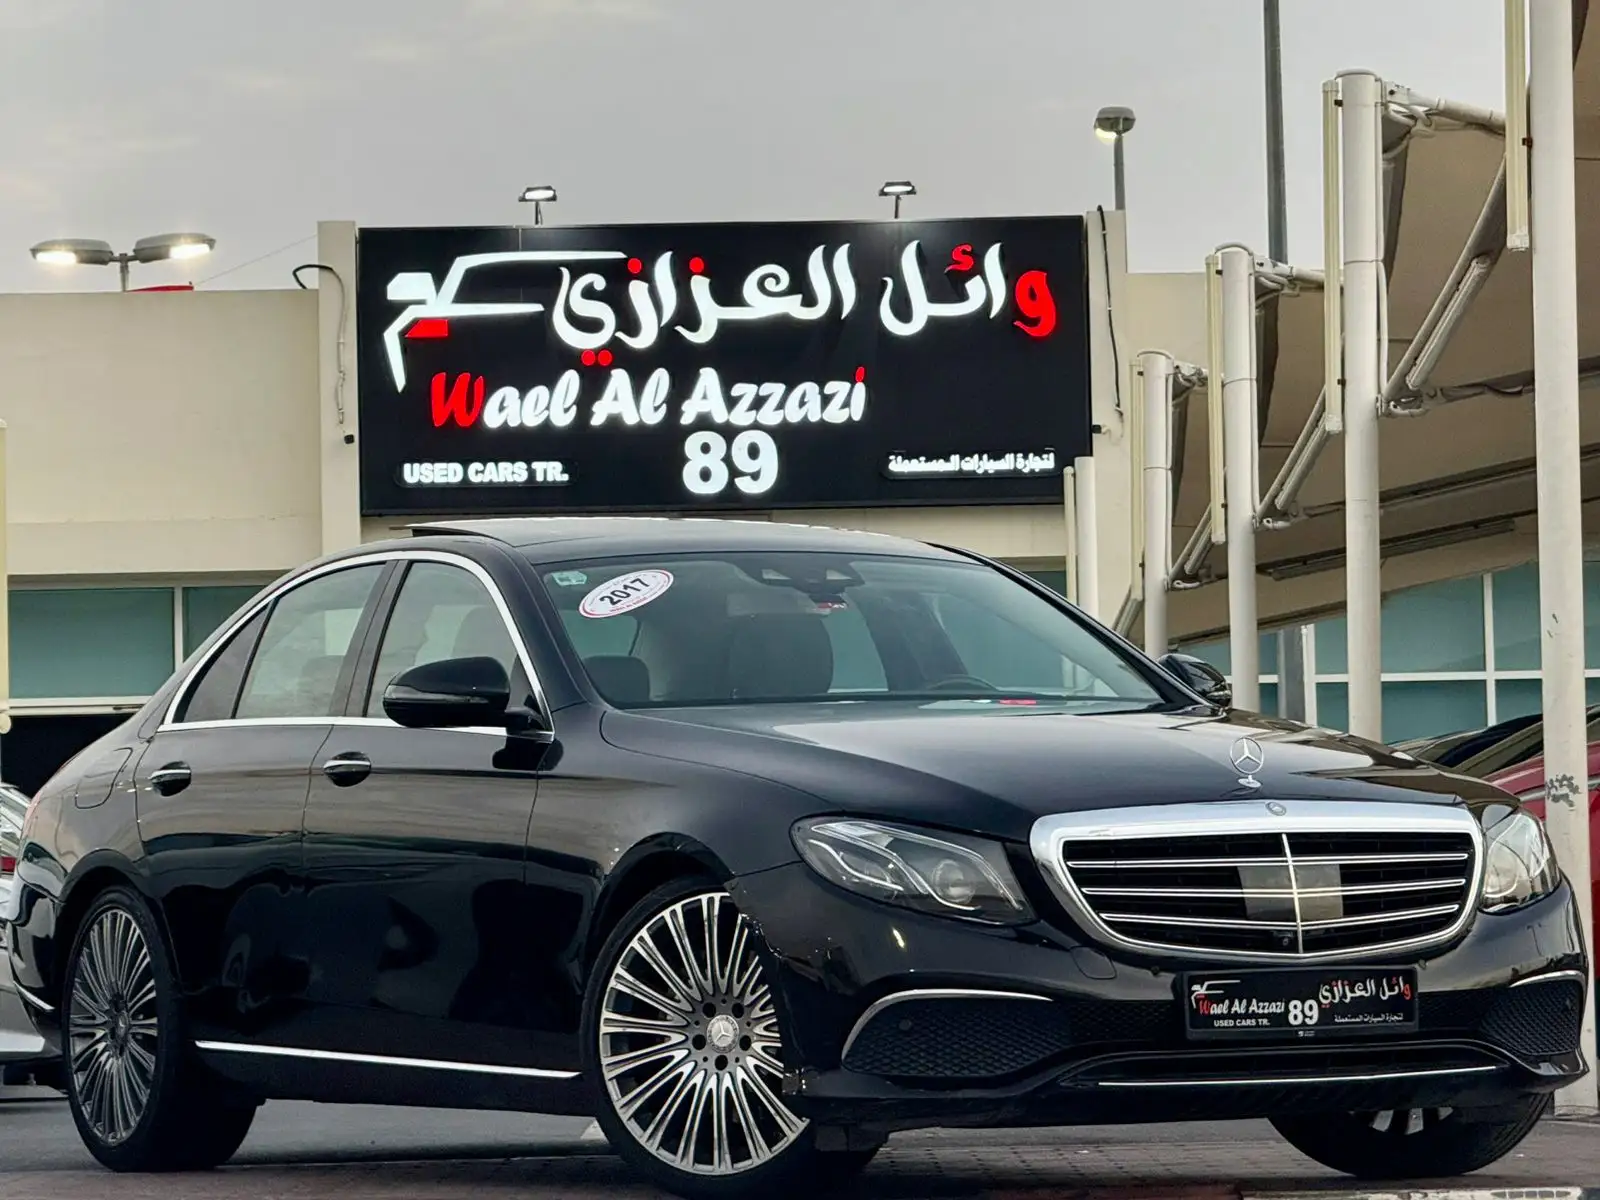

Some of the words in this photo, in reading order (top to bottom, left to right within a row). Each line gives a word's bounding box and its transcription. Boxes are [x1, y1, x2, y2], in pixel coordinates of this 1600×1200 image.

[880, 240, 1056, 337] وائل
[552, 243, 857, 366] العزازي
[431, 369, 580, 428] Wael
[590, 368, 671, 425] Al
[680, 366, 866, 426] Azzazi
[403, 462, 464, 483] USED
[467, 461, 528, 482] CARS
[531, 461, 570, 481] TR.
[682, 430, 778, 495] 89
[888, 454, 960, 473] المستعملة
[960, 453, 1014, 474] السيارات
[600, 578, 650, 606] 2017
[1319, 978, 1376, 1008] العزازي
[1380, 976, 1411, 1000] وائل
[1199, 999, 1230, 1015] Wael
[1231, 998, 1247, 1014] Al
[1248, 997, 1285, 1014] Azzazi
[1288, 999, 1319, 1026] 89
[1213, 1019, 1234, 1027] USED
[1257, 1018, 1270, 1026] TR.
